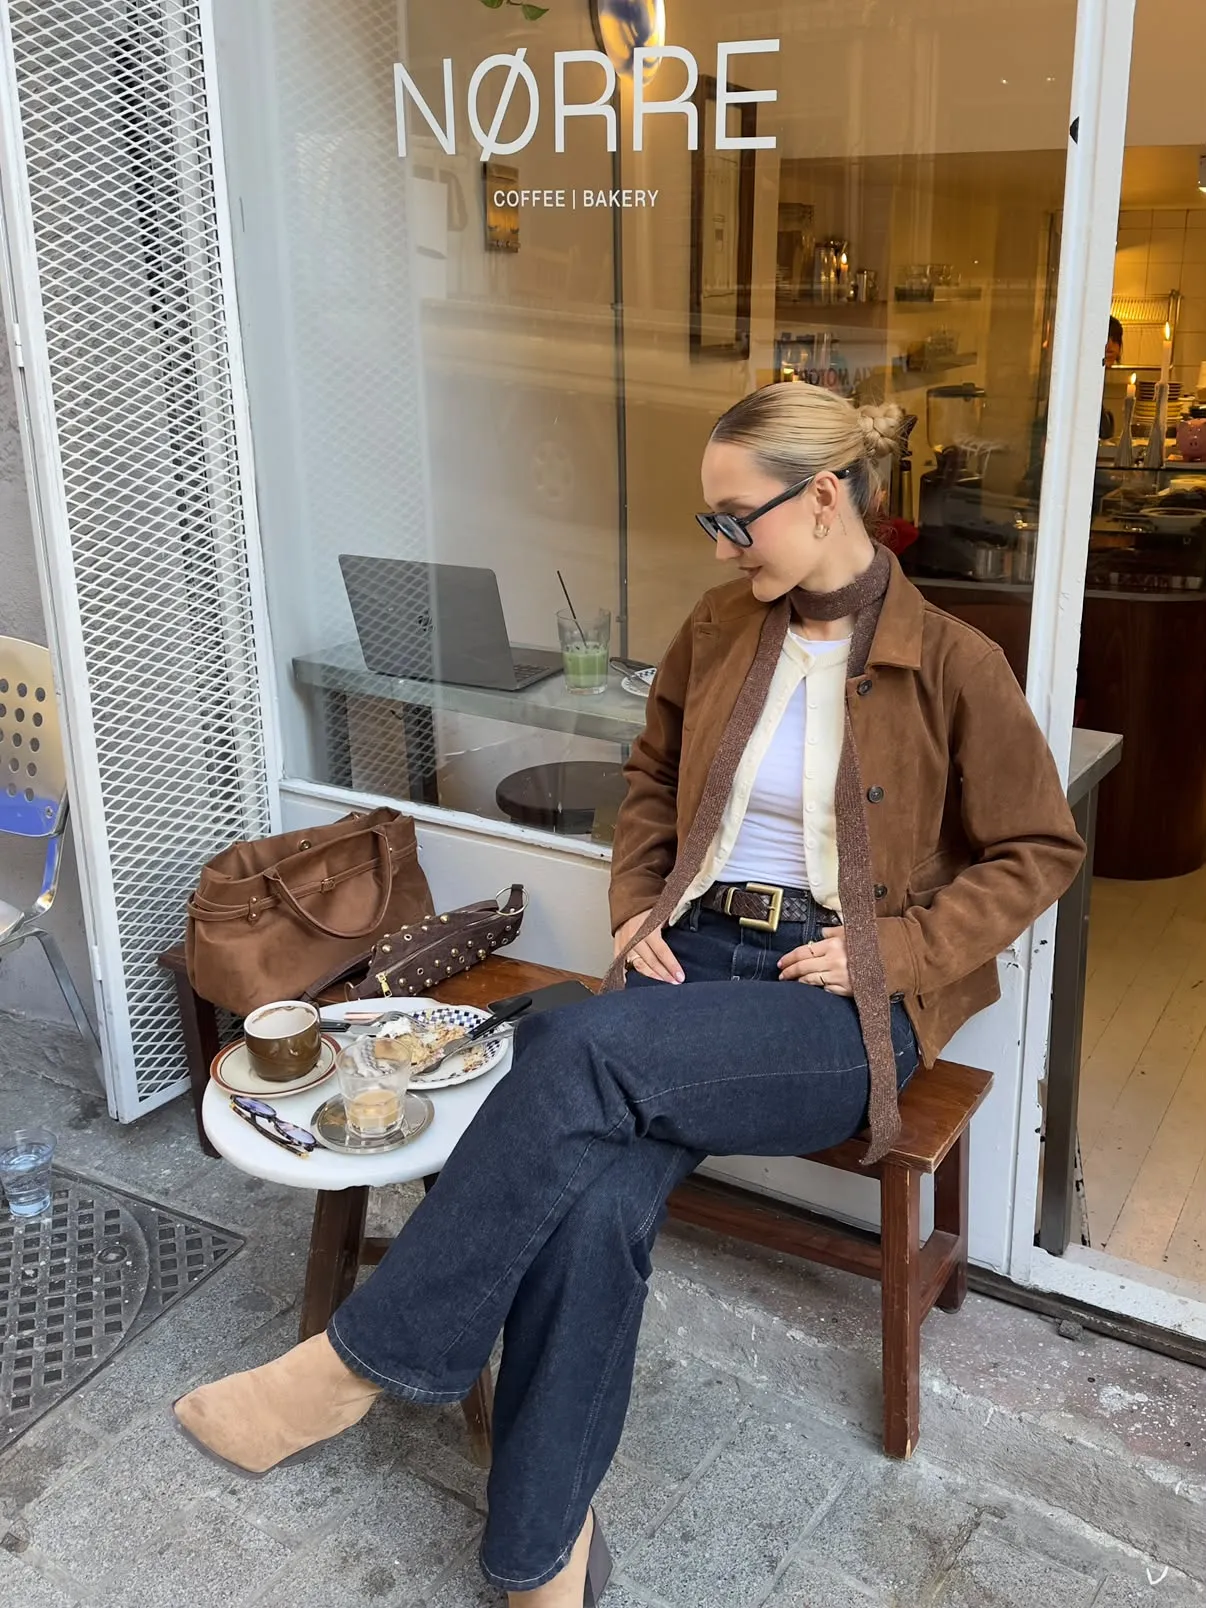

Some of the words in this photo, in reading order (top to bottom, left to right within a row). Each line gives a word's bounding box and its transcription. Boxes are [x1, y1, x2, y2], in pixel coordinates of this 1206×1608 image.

[393, 38, 780, 162] NØRRE
[493, 189, 566, 208] COFFEE
[583, 189, 659, 208] BAKERY
